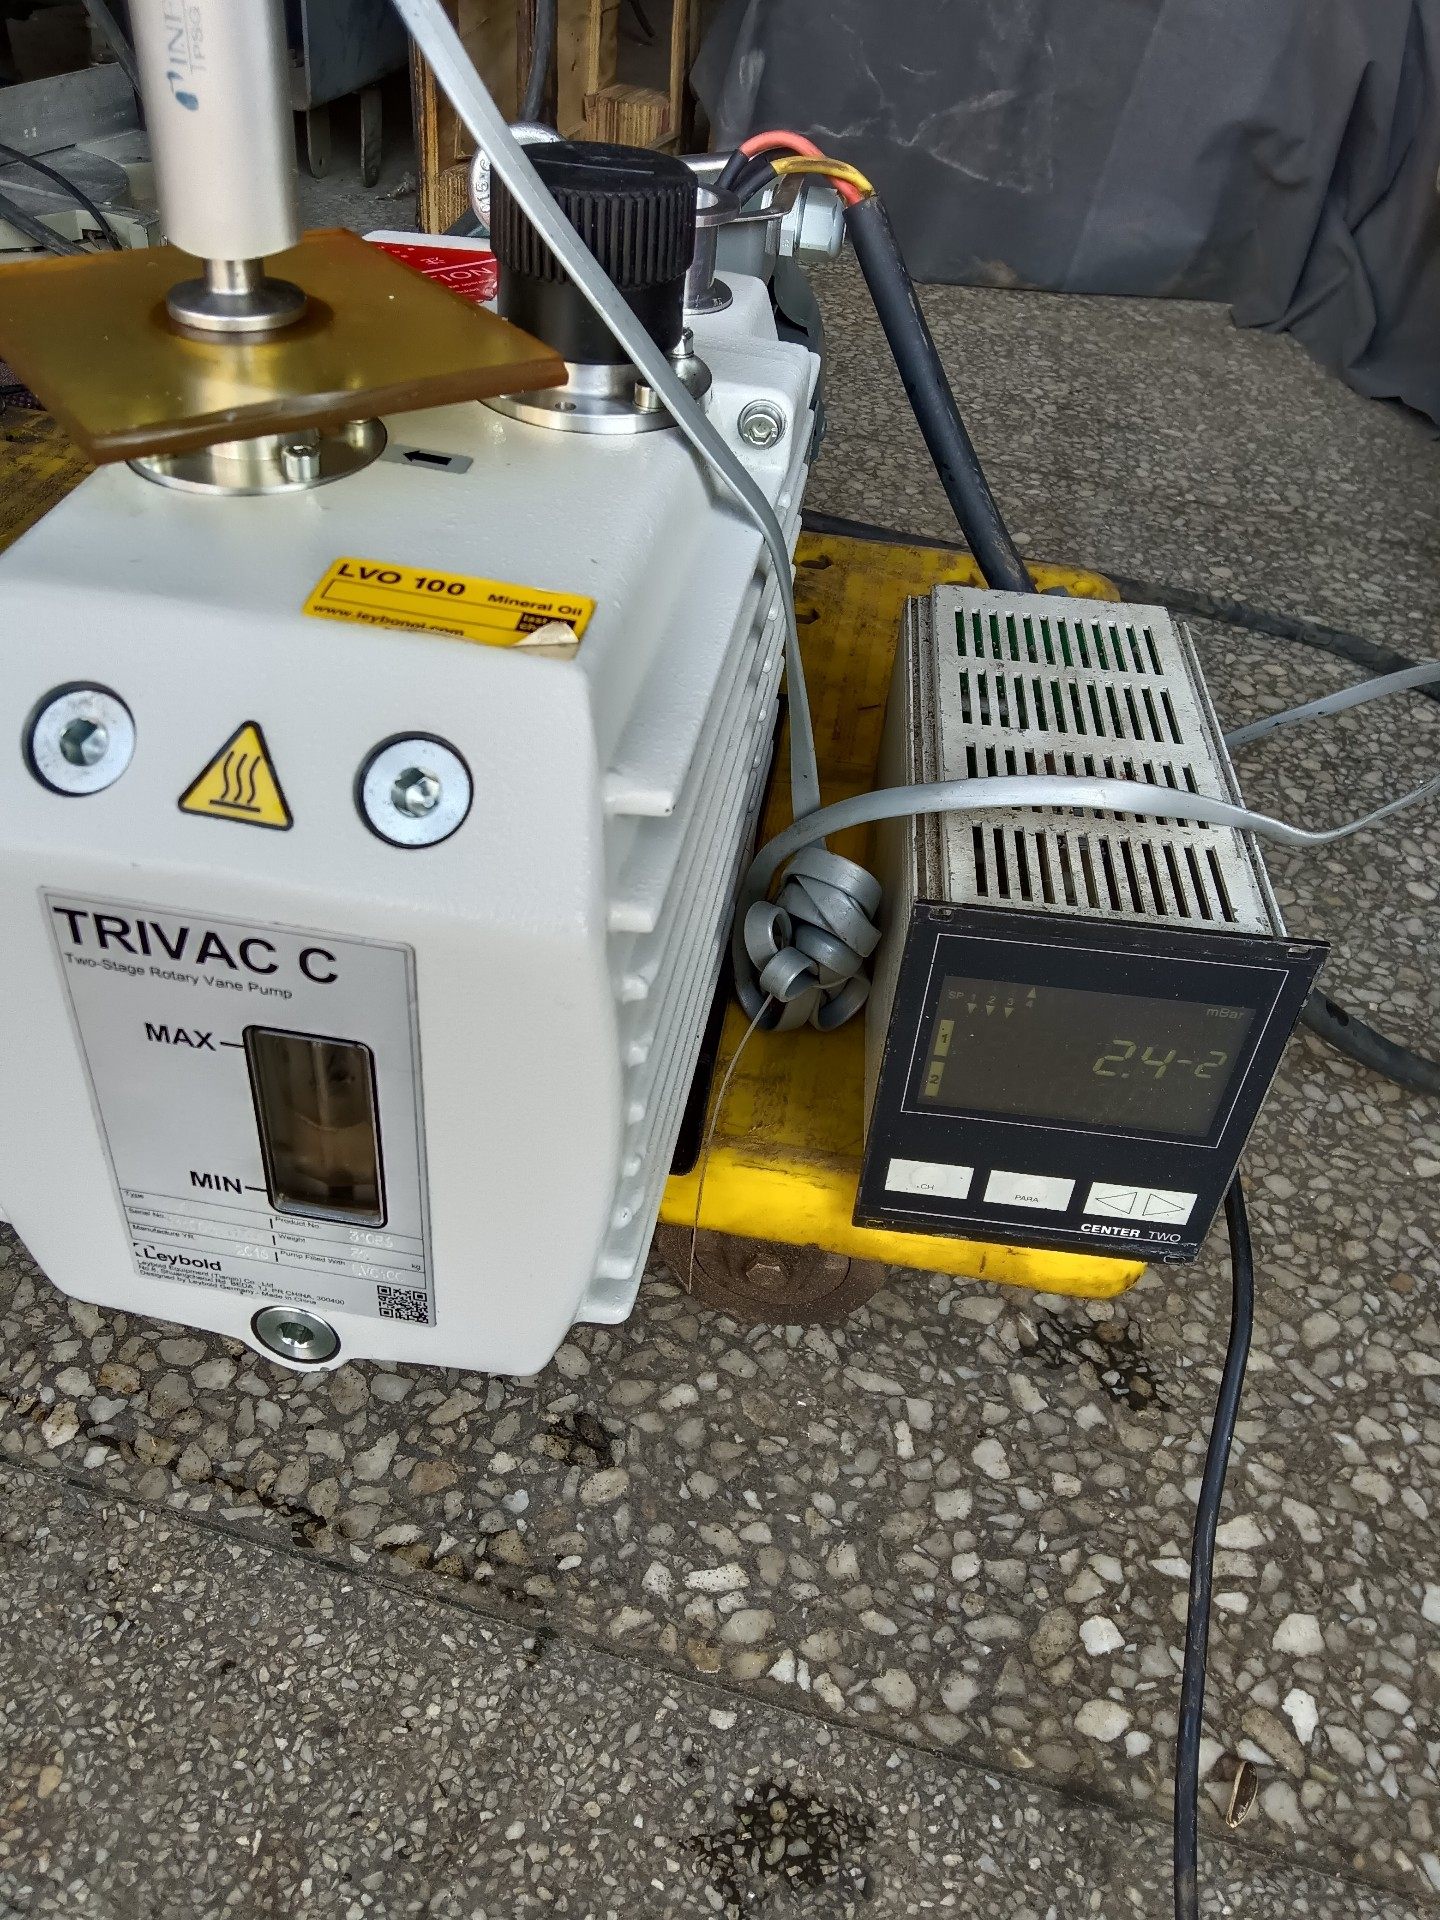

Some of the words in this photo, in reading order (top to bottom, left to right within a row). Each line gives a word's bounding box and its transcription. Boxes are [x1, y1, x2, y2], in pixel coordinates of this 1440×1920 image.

[337, 562, 402, 584] LVO
[415, 577, 466, 596] 100
[488, 593, 553, 611] Mineral
[558, 605, 583, 616] Oil
[52, 906, 280, 975] TRIVAC
[299, 947, 338, 984] C
[65, 952, 145, 977] Two-Stage
[150, 966, 198, 986] Rotary
[202, 975, 244, 992] Vane
[248, 981, 293, 1000] Pump
[948, 990, 965, 999] SP
[1206, 1007, 1245, 1020] mBar
[145, 1022, 217, 1051] MAX
[929, 1074, 940, 1085] 2
[190, 1170, 242, 1195] MIN
[1014, 1194, 1040, 1203] PARA
[275, 1216, 306, 1228] Product
[278, 1233, 306, 1244] Weight
[1081, 1223, 1141, 1238] CENTER
[1148, 1230, 1181, 1243] TWO
[143, 1247, 222, 1272] Leybold
[280, 1250, 303, 1260] Pump
[411, 1263, 421, 1272] kg
